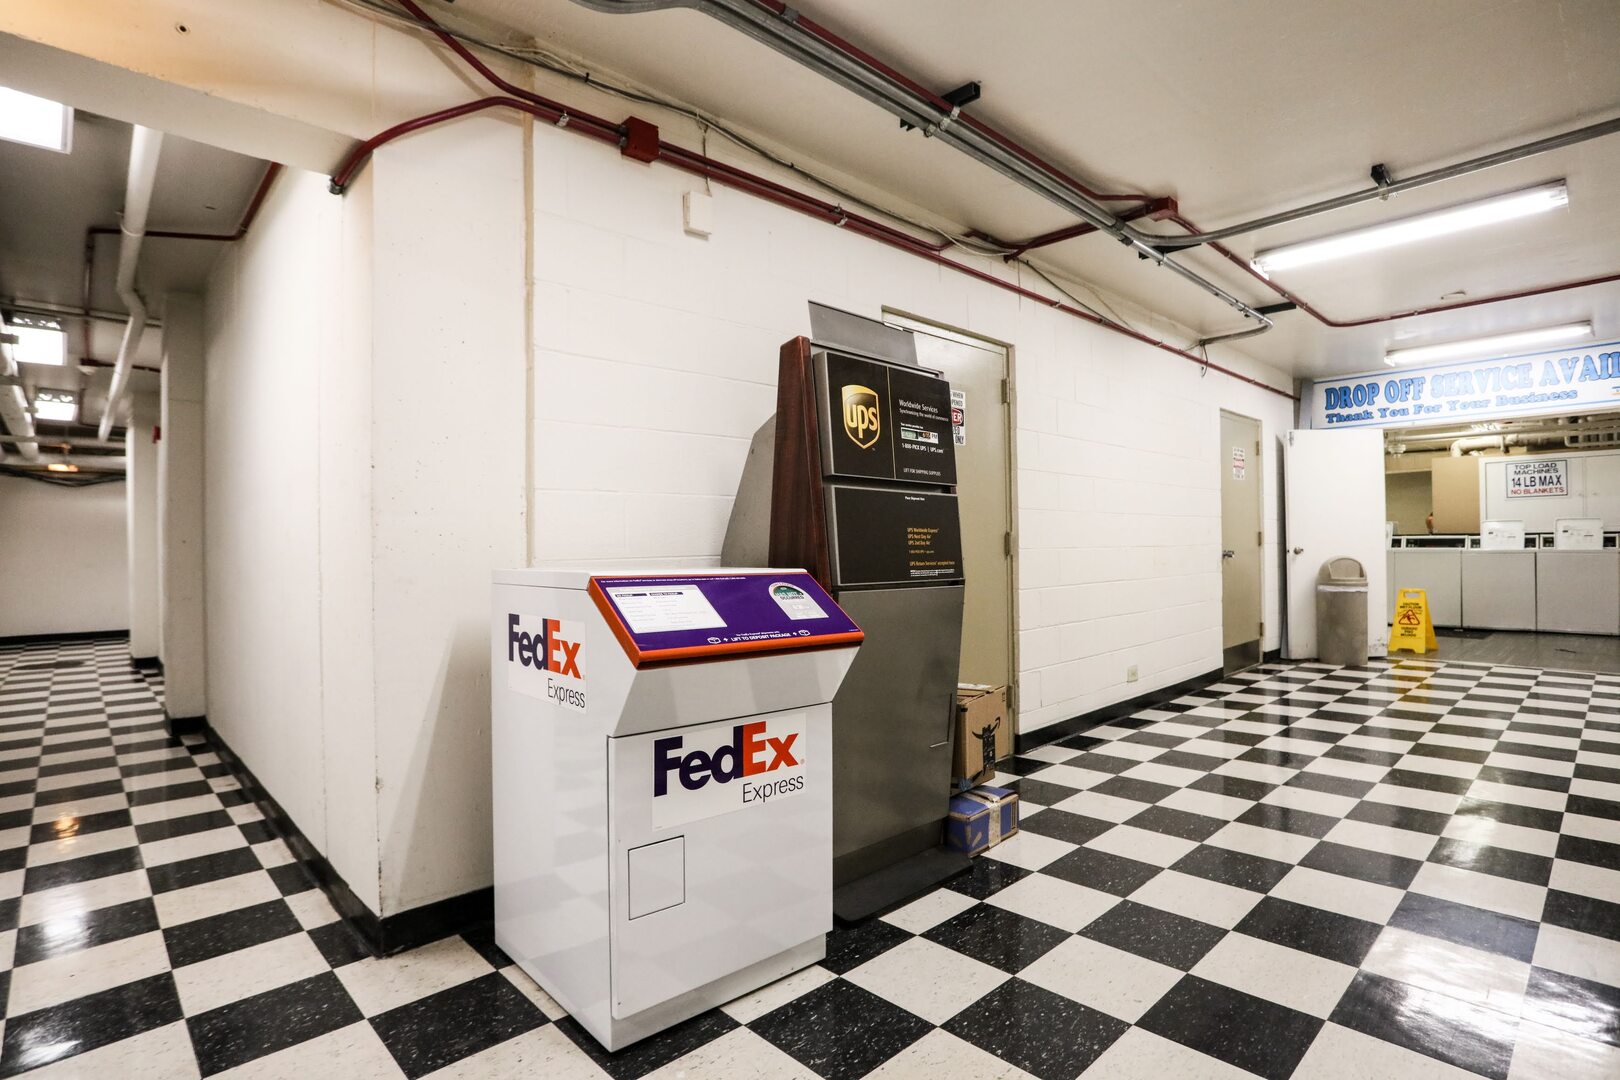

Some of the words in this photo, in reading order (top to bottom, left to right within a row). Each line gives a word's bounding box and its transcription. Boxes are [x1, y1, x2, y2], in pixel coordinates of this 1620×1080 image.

[1325, 383, 1379, 410] DROP
[1384, 376, 1426, 403] OFF
[1430, 362, 1533, 399] SERVICE
[846, 404, 878, 439] ups
[899, 399, 921, 410] Worldwide
[921, 404, 939, 413] Services
[1326, 410, 1374, 423] Thank
[1378, 407, 1409, 418] You
[1413, 403, 1442, 414] For
[1447, 400, 1491, 411] Your
[1495, 390, 1577, 406] Business
[1511, 477, 1521, 488] 14
[1524, 476, 1536, 487] LB
[1539, 475, 1562, 486] MAX
[508, 613, 582, 680] FedEx
[547, 677, 585, 709] Express
[654, 721, 799, 797] FedEx
[742, 775, 804, 804] Express
